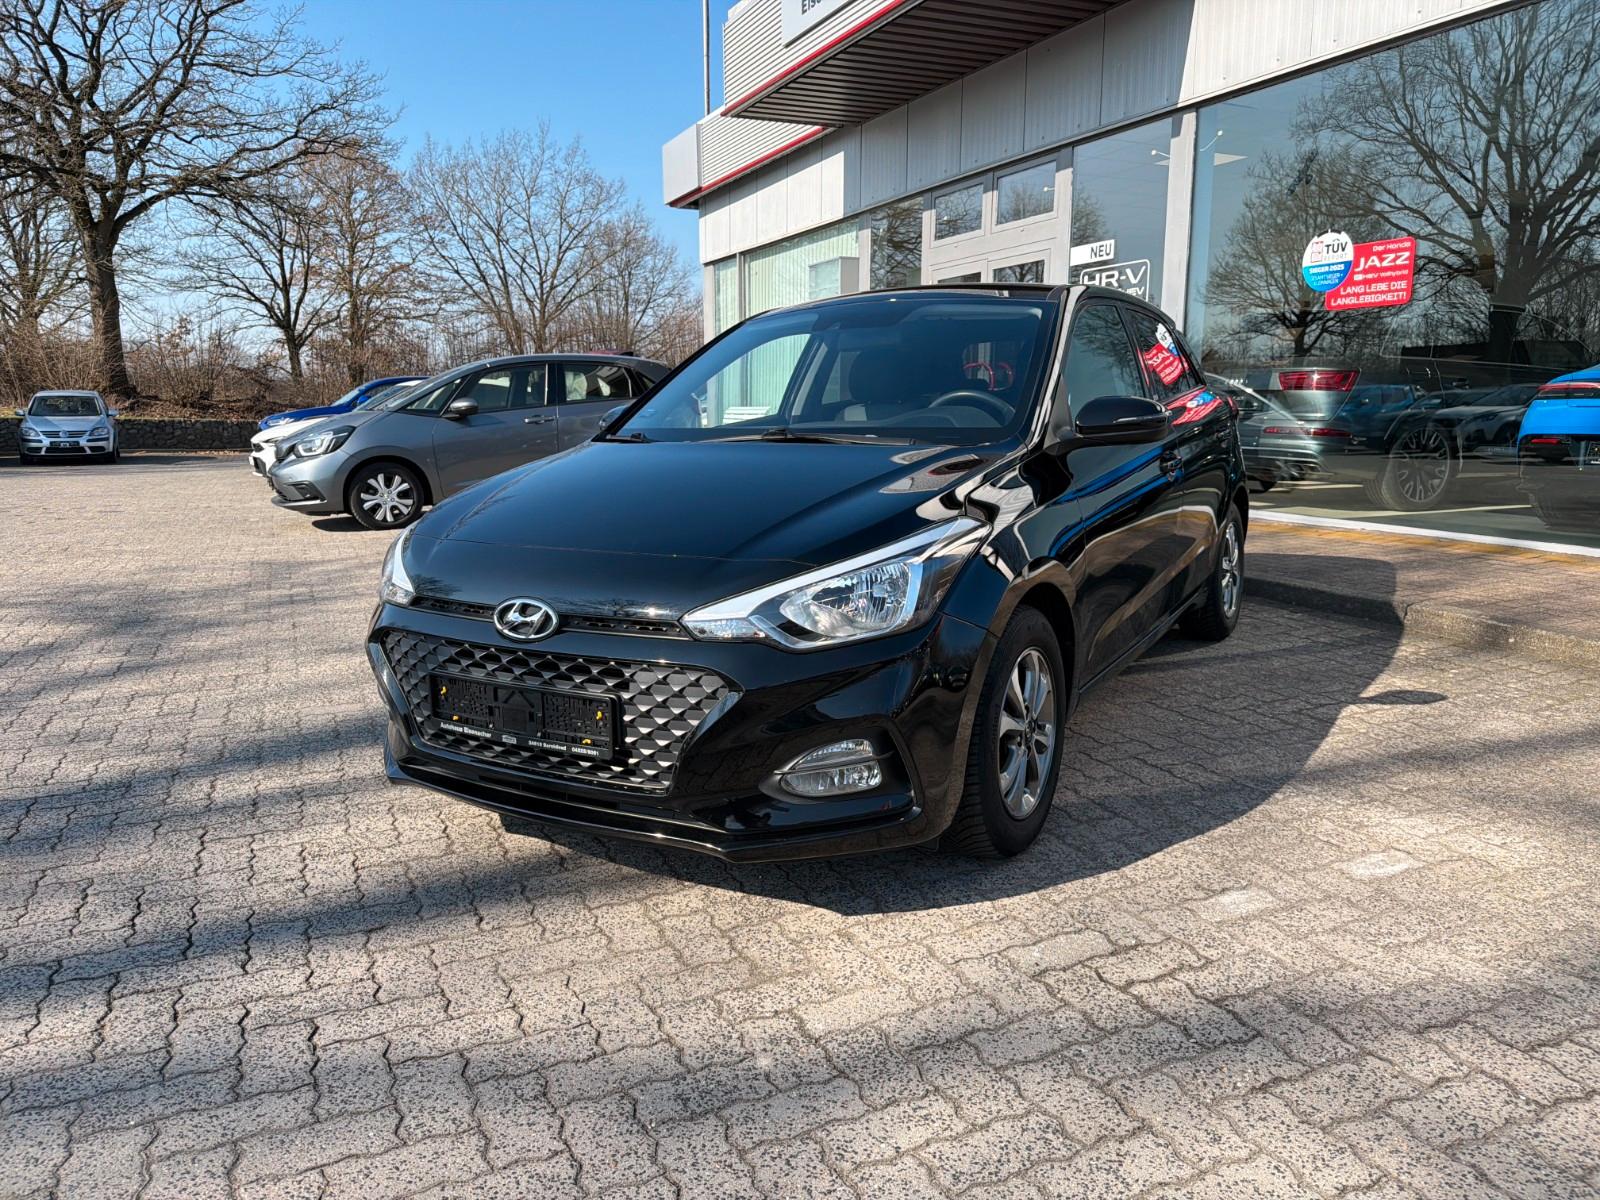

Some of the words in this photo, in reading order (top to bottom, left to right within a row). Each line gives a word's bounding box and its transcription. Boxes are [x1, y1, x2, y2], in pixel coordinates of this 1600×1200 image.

[1090, 243, 1112, 259] NEU
[1324, 238, 1348, 254] TÜV
[1386, 241, 1411, 249] Honda
[1354, 251, 1410, 272] JAZZ
[1340, 285, 1365, 295] LANG
[1366, 282, 1389, 292] LEBE
[1390, 280, 1408, 290] DIE
[1331, 291, 1406, 306] LANGLEBIGKEIT!
